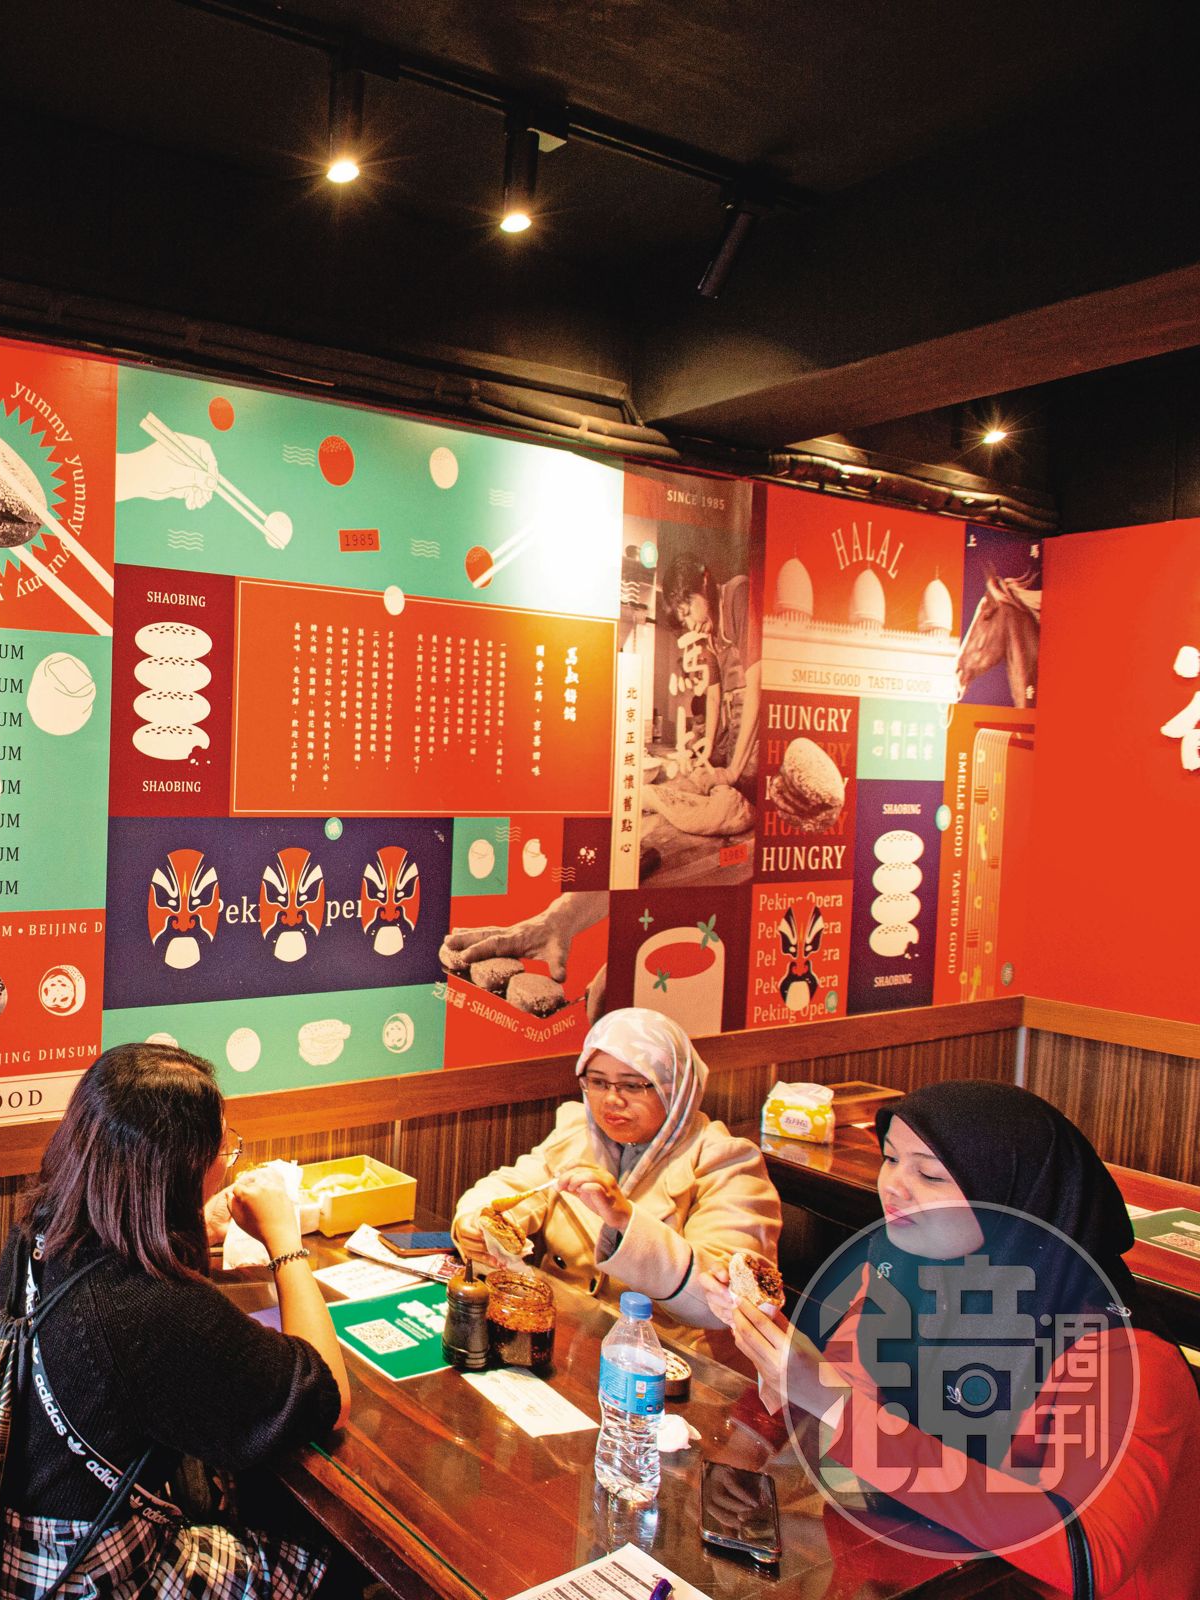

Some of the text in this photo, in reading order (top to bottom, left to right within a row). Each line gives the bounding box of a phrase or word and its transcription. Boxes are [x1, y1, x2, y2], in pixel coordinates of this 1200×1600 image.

[10, 381, 72, 443] yummy
[65, 455, 87, 536] yummy
[666, 489, 725, 511] SINCE 1985
[343, 533, 375, 547] 1985
[831, 521, 904, 579] HALAL
[146, 590, 207, 607] SHAOBING
[792, 668, 861, 688] SMELLS GOOD
[867, 676, 903, 690] TASTED
[767, 704, 852, 732] HUNGRY
[142, 780, 201, 793] SHAOBING
[882, 803, 921, 815] SHAOBING
[954, 752, 968, 857] SMELLS GOOD
[761, 845, 846, 872] HUNGRY
[29, 922, 87, 938] BEIJING
[948, 870, 961, 974] TASTED GOOD
[873, 973, 912, 988] SHAOBING
[469, 1001, 576, 1043] SHAOBING SHAO BING
[38, 1045, 97, 1061] DIMSUM
[35, 1373, 68, 1437] adidas
